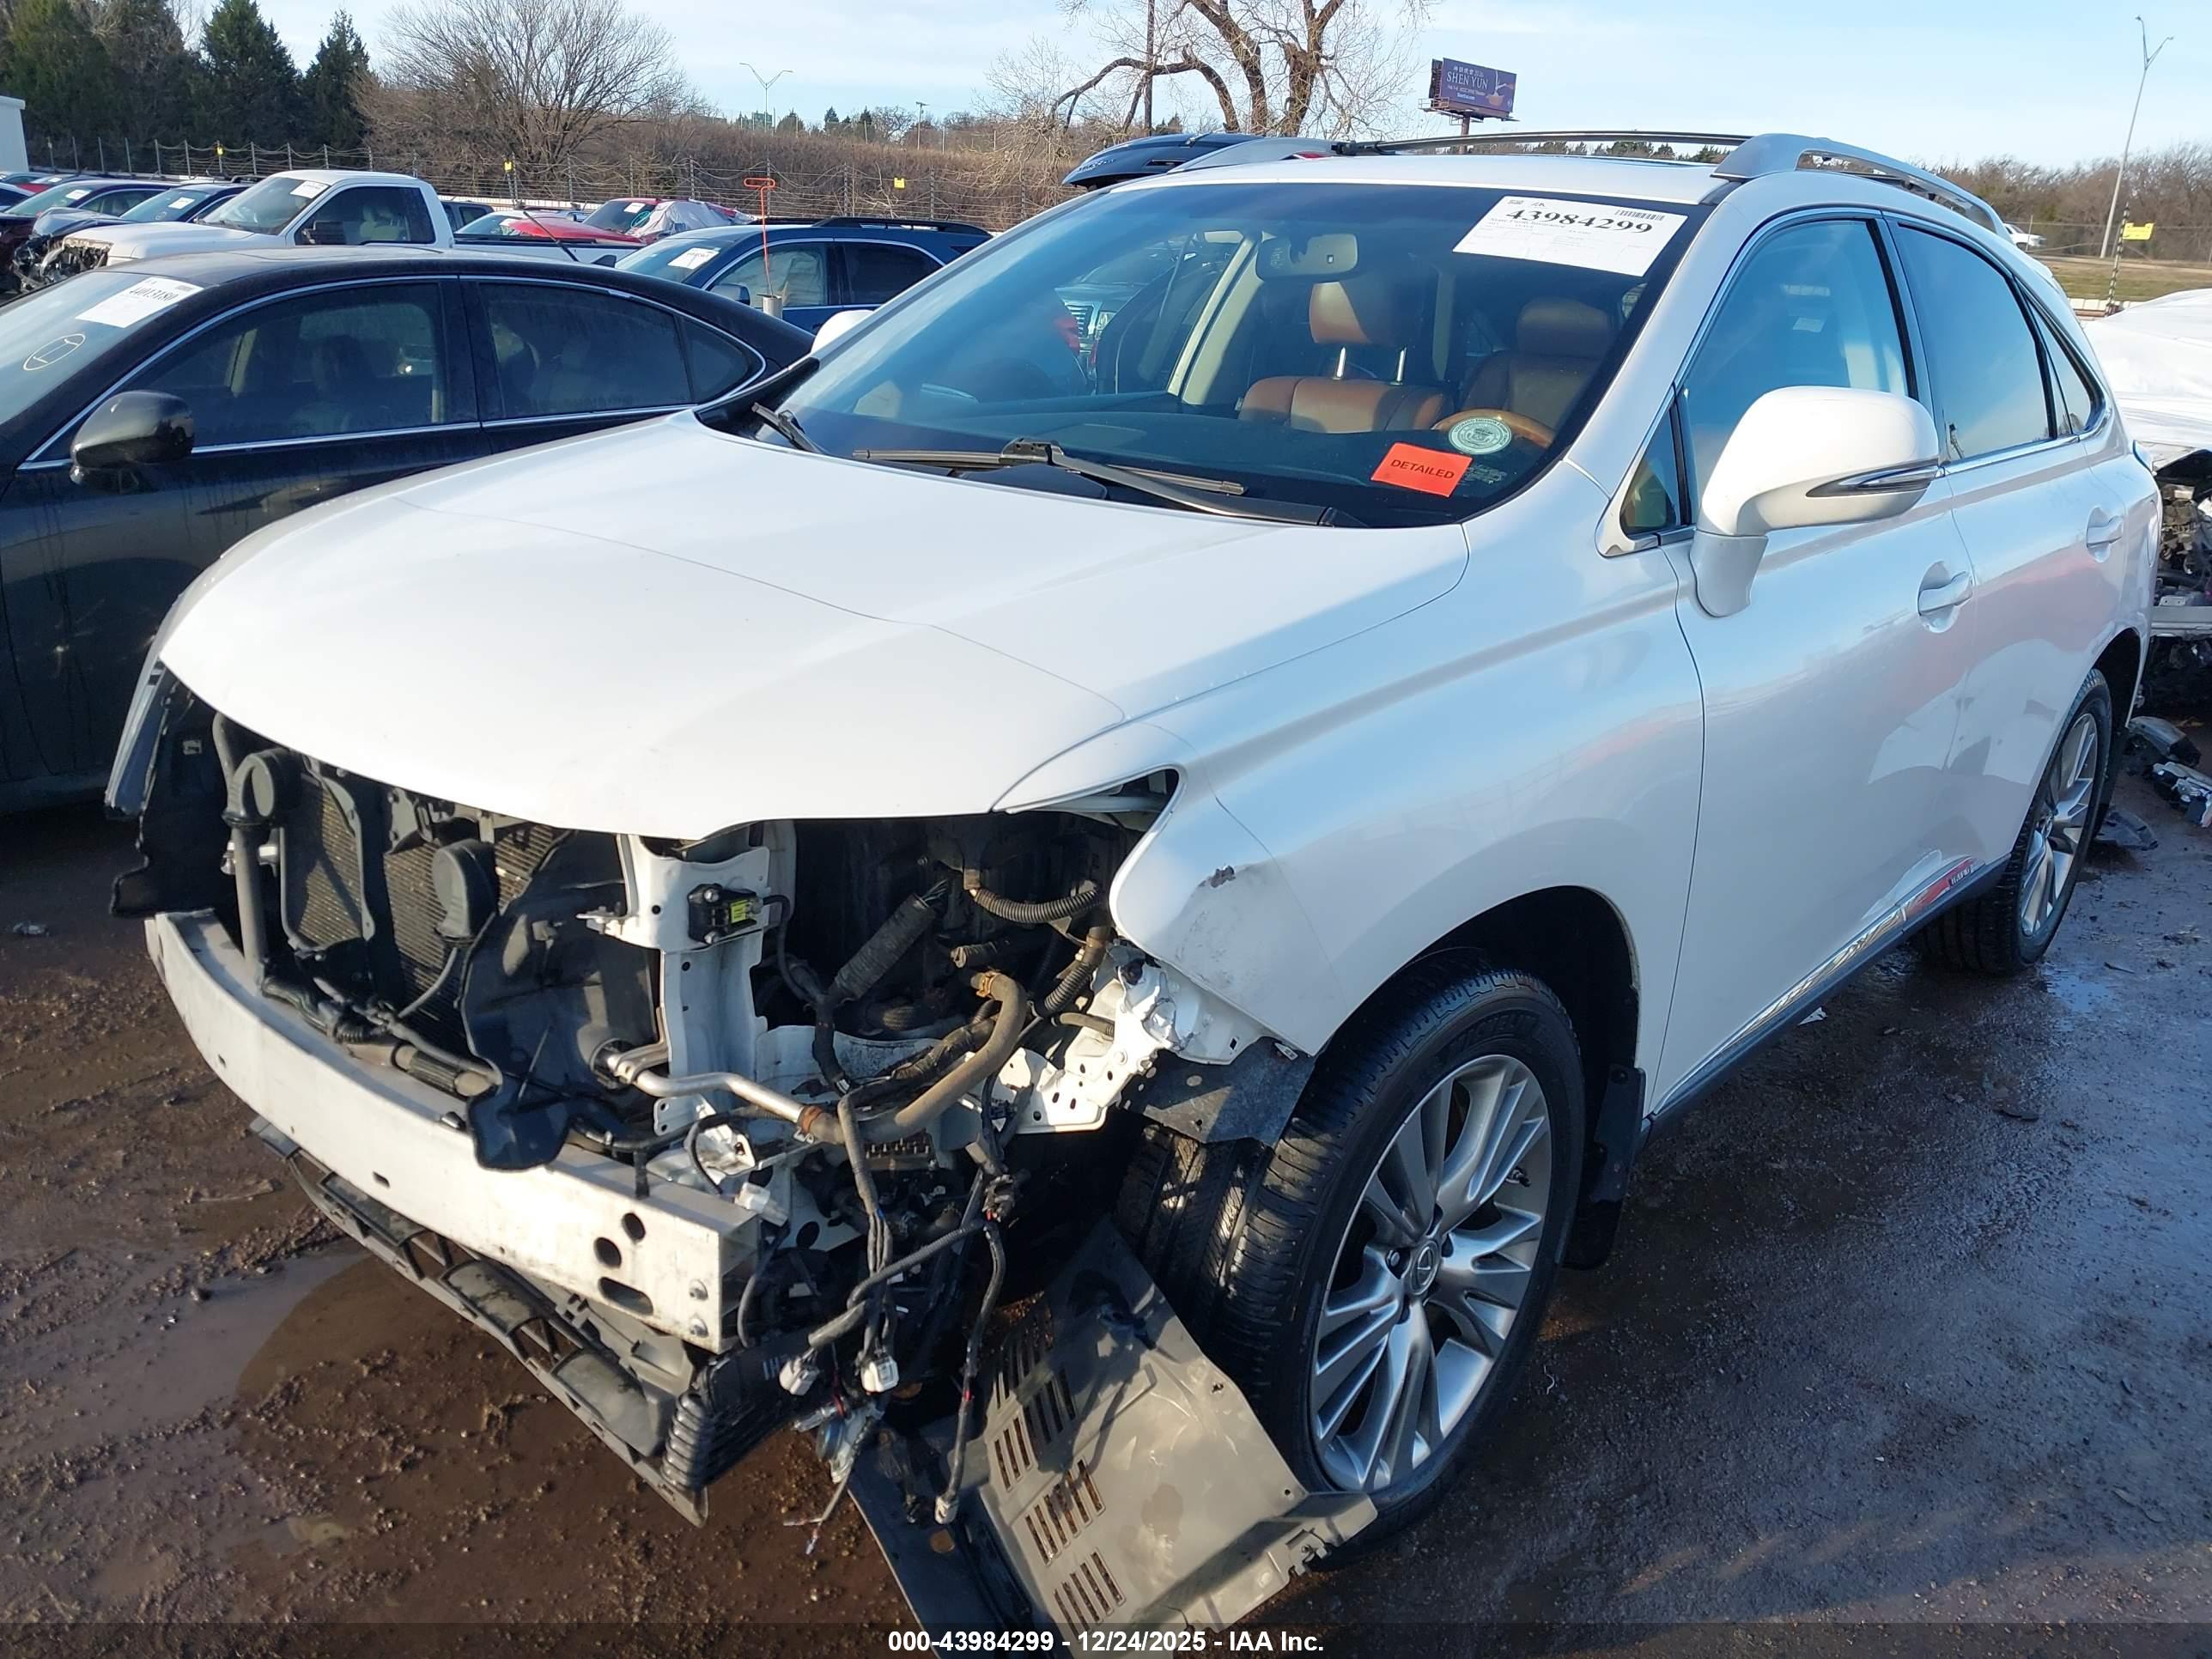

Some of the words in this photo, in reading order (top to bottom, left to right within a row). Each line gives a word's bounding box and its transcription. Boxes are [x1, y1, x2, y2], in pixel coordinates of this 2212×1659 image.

[1446, 70, 1469, 85] SHEN
[1471, 76, 1488, 90] YUN
[1506, 209, 1653, 234] 43984299
[1390, 459, 1455, 480] DETAILED
